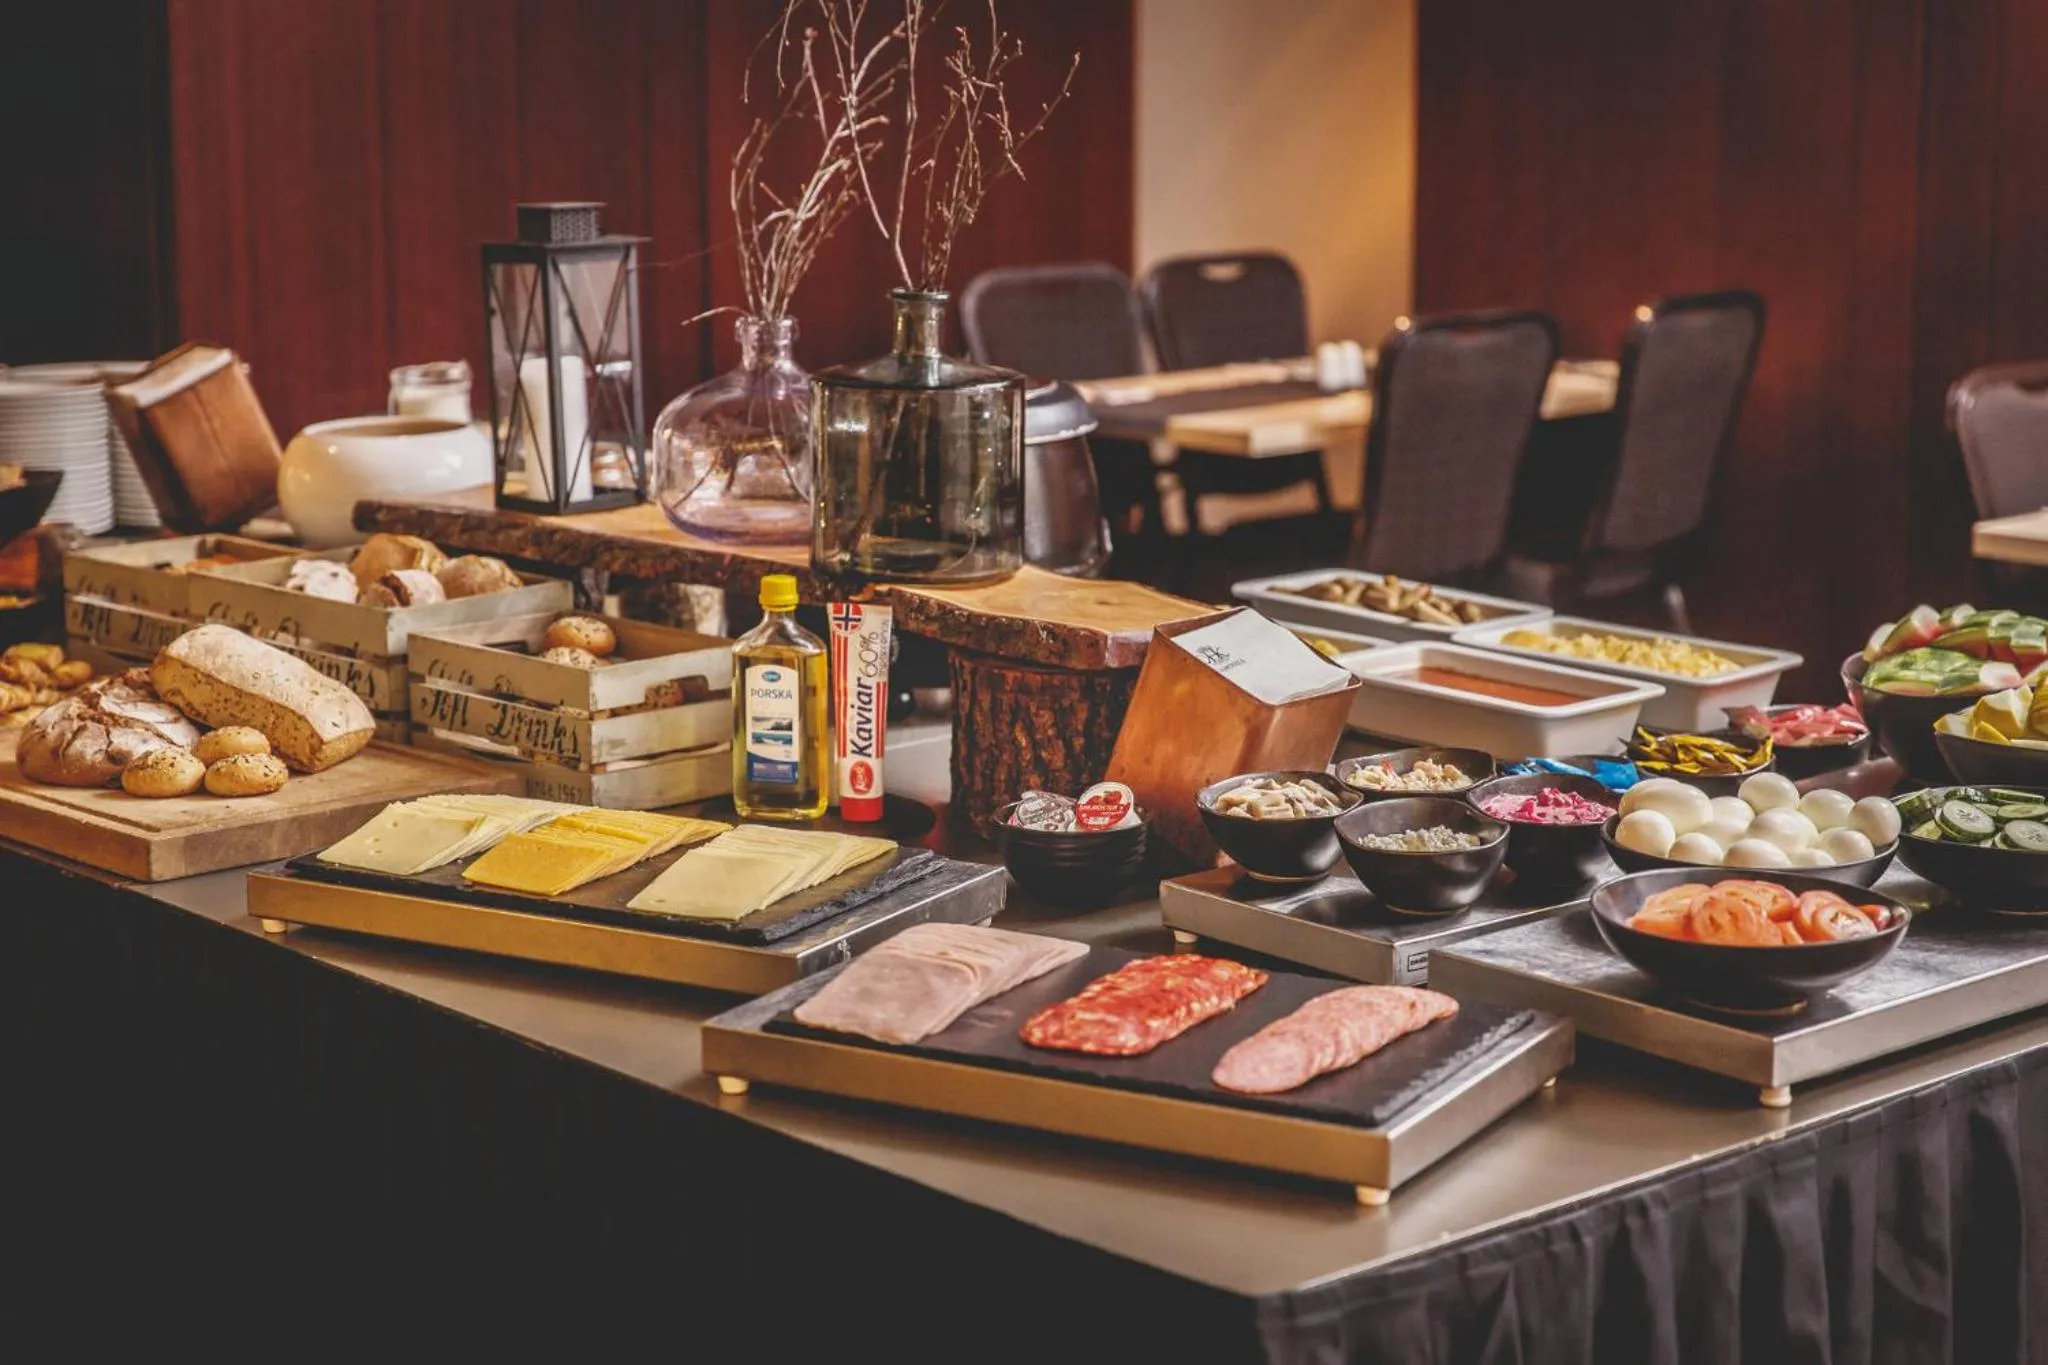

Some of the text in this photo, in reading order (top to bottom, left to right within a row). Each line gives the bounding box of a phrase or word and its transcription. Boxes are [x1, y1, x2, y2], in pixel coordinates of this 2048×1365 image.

[859, 632, 878, 677] 60%
[485, 675, 580, 754] Drinks
[850, 677, 872, 757] Kaviar
